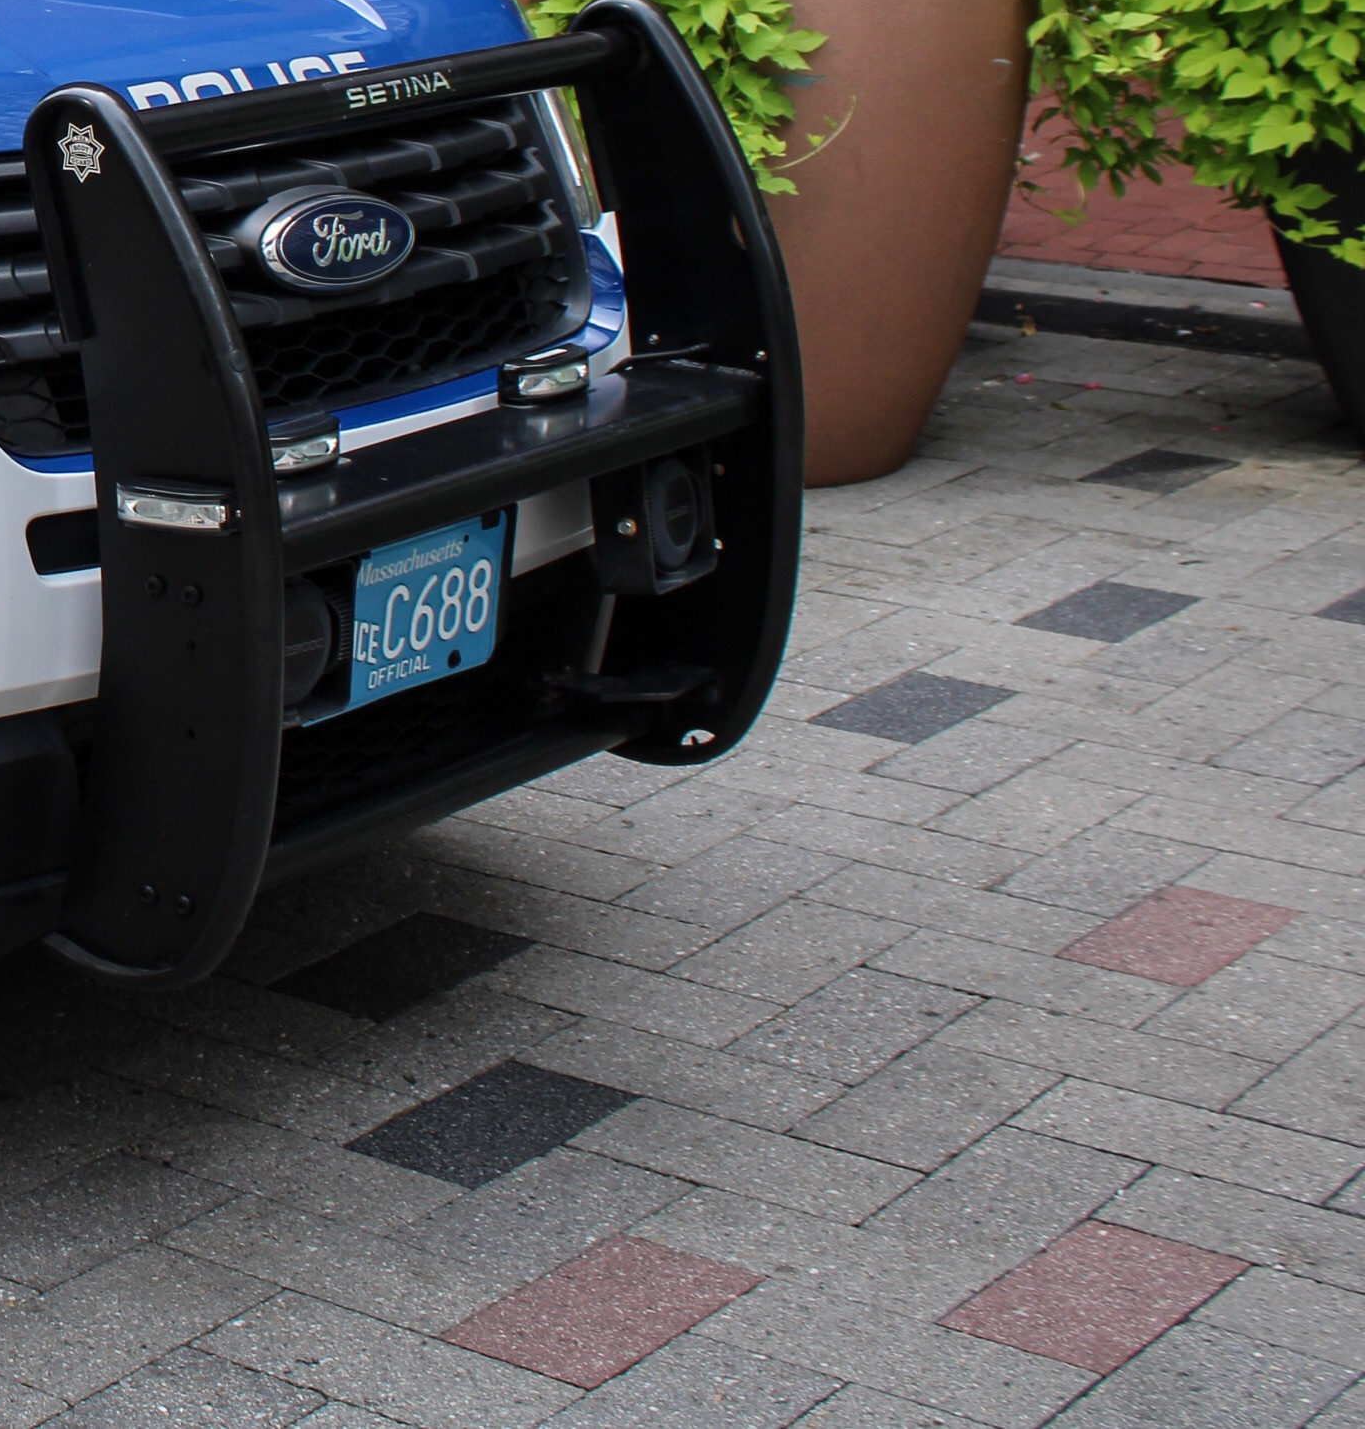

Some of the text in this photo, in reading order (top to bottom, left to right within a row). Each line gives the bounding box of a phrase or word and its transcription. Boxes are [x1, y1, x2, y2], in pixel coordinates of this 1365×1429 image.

[346, 71, 451, 109] SETINA
[312, 210, 392, 268] Ford
[357, 539, 464, 588] Massachusetts
[383, 559, 493, 660] C688
[368, 654, 432, 690] OFFICIAL
